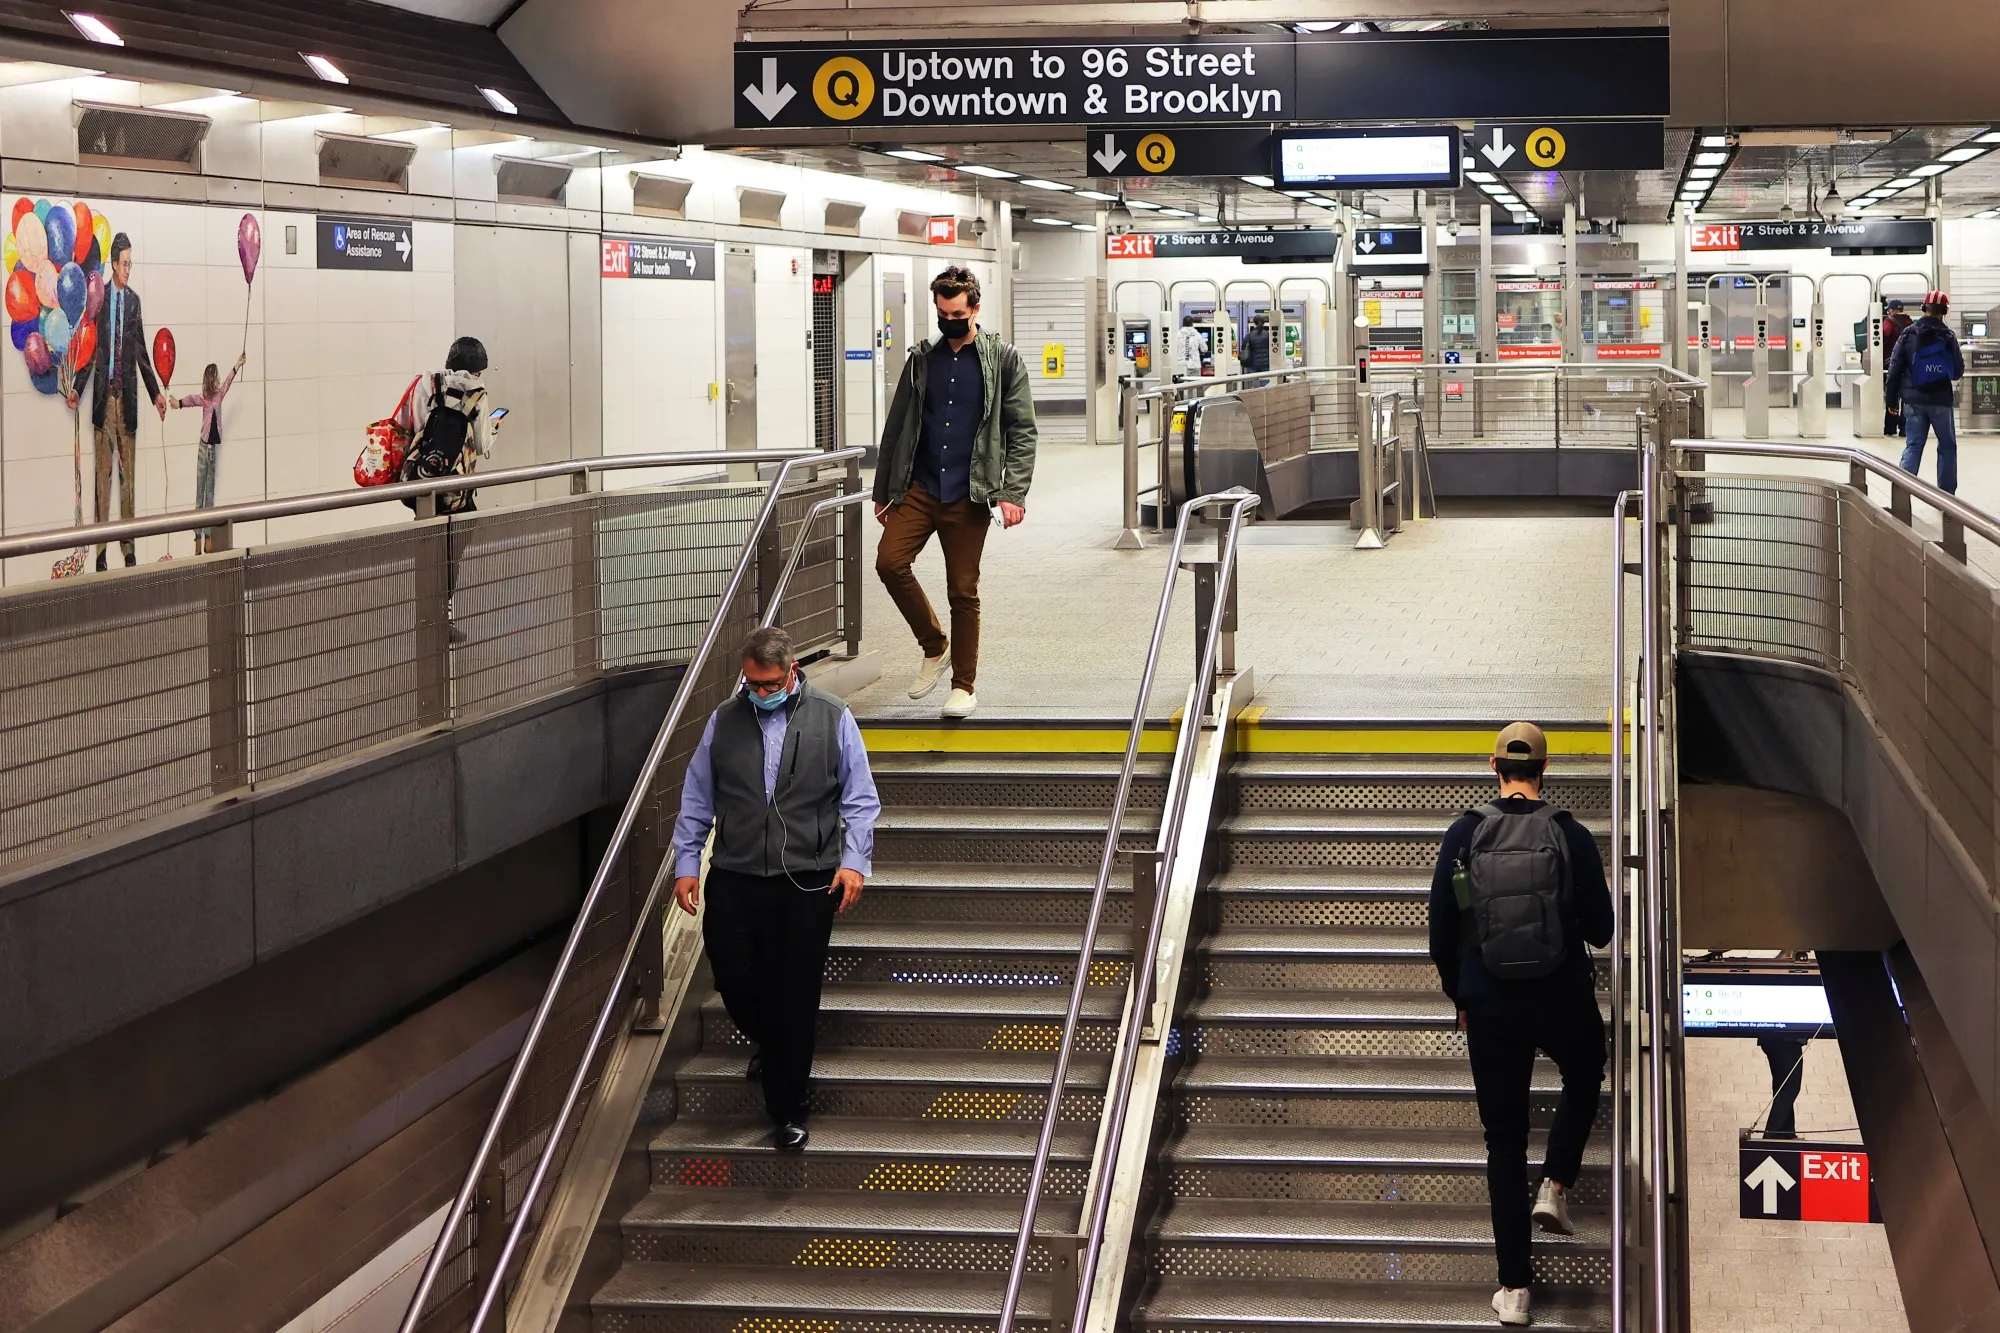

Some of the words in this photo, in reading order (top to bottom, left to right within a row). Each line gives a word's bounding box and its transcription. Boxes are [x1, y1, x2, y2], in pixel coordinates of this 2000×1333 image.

[882, 51, 1014, 87] Uptown
[1029, 49, 1066, 79] to
[1081, 47, 1129, 78] 96
[1145, 46, 1256, 77] Street
[827, 70, 860, 107] Q
[882, 86, 1067, 117] Downtown
[1083, 83, 1108, 114] &
[1125, 83, 1282, 119] Brooklyn
[1145, 141, 1166, 165] Q
[1534, 136, 1556, 160] Q
[346, 226, 362, 240] Area
[362, 228, 371, 240] of
[371, 227, 396, 242] Rescue
[1107, 236, 1152, 255] Exit
[1153, 234, 1168, 245] 72
[1171, 234, 1205, 244] Street
[1210, 234, 1218, 244] &
[1223, 234, 1230, 244] 2
[1234, 234, 1275, 244] Avenue
[1691, 228, 1738, 246] Exit
[1739, 225, 1754, 236] 72
[1758, 225, 1794, 235] Street
[1798, 225, 1807, 235] &
[1811, 224, 1819, 235] 2
[1824, 224, 1866, 235] Avenue
[346, 243, 383, 258] Assistance
[602, 242, 627, 273] Exit
[634, 243, 641, 258] 72
[641, 245, 658, 259] Street
[668, 247, 687, 260] Avenue
[633, 260, 641, 274] 24
[641, 261, 654, 275] hour
[654, 262, 671, 276] booth
[1404, 290, 1420, 298] EXIT
[1639, 281, 1655, 289] EXIT
[1925, 364, 1943, 373] NYC
[1705, 990, 1713, 998] Q
[1705, 1008, 1713, 1016] Q
[1803, 1154, 1861, 1181] Exit
